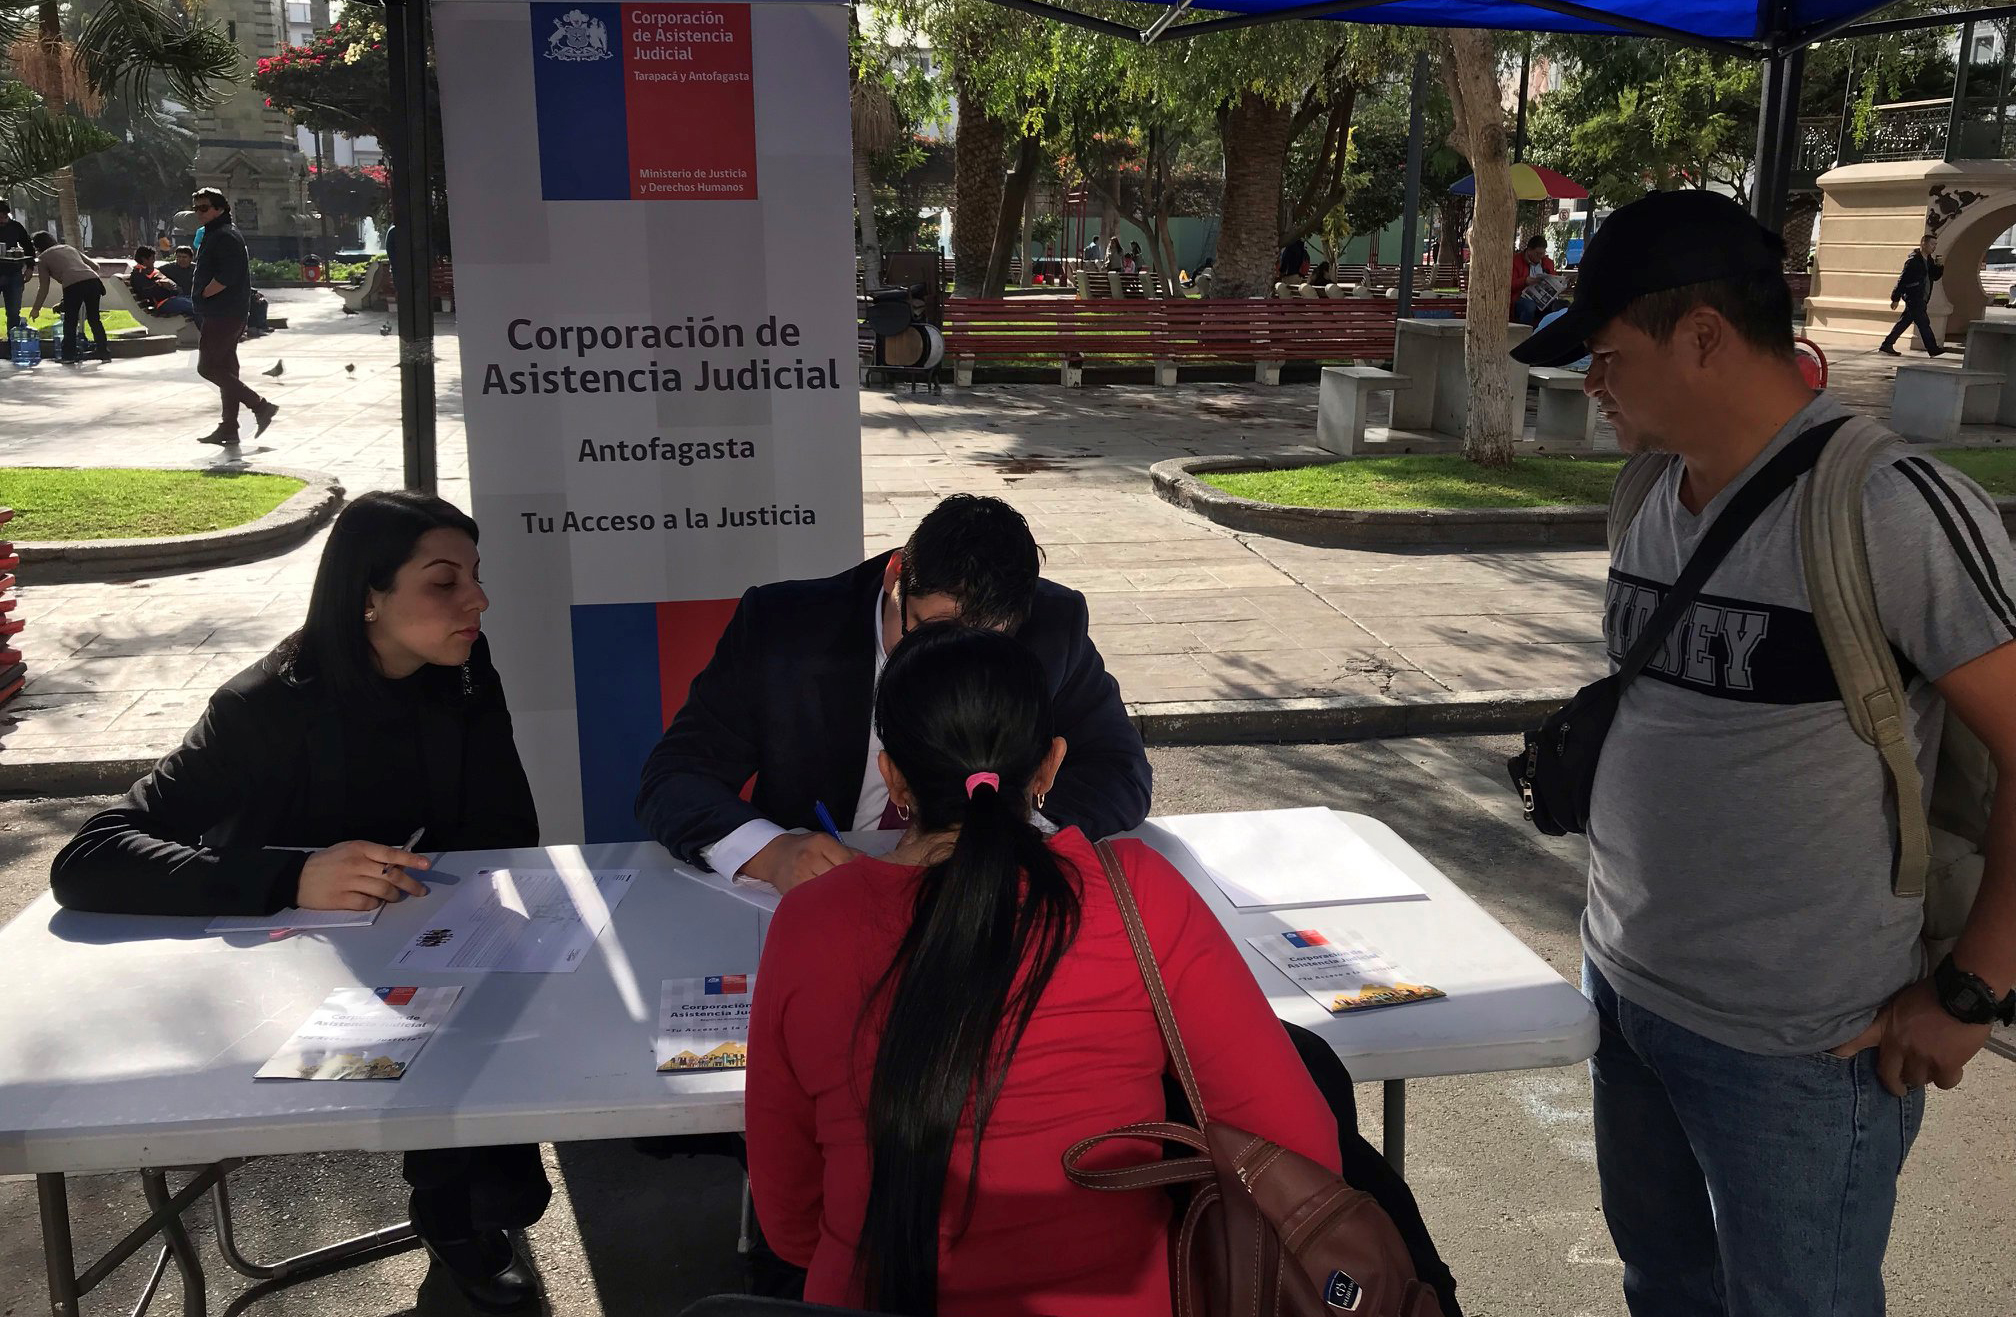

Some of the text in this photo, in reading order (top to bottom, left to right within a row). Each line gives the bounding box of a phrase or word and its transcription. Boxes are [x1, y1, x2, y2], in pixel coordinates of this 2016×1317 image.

[631, 10, 725, 27] Corporación
[632, 28, 734, 42] de Asistencia
[633, 46, 693, 60] Judicial
[633, 71, 750, 83] Tarapacá y Antofagasta
[639, 168, 748, 178] Ministerio de Justicia
[640, 182, 744, 194] y Derechos Humanos
[507, 315, 801, 357] Corporación de
[482, 358, 840, 395] Asistencia Judicial
[578, 437, 756, 466] Antofagasta
[521, 504, 817, 534] Tu Acceso a la Justicia
[1287, 959, 1340, 969] Asistencia
[681, 1003, 752, 1011] Corporación
